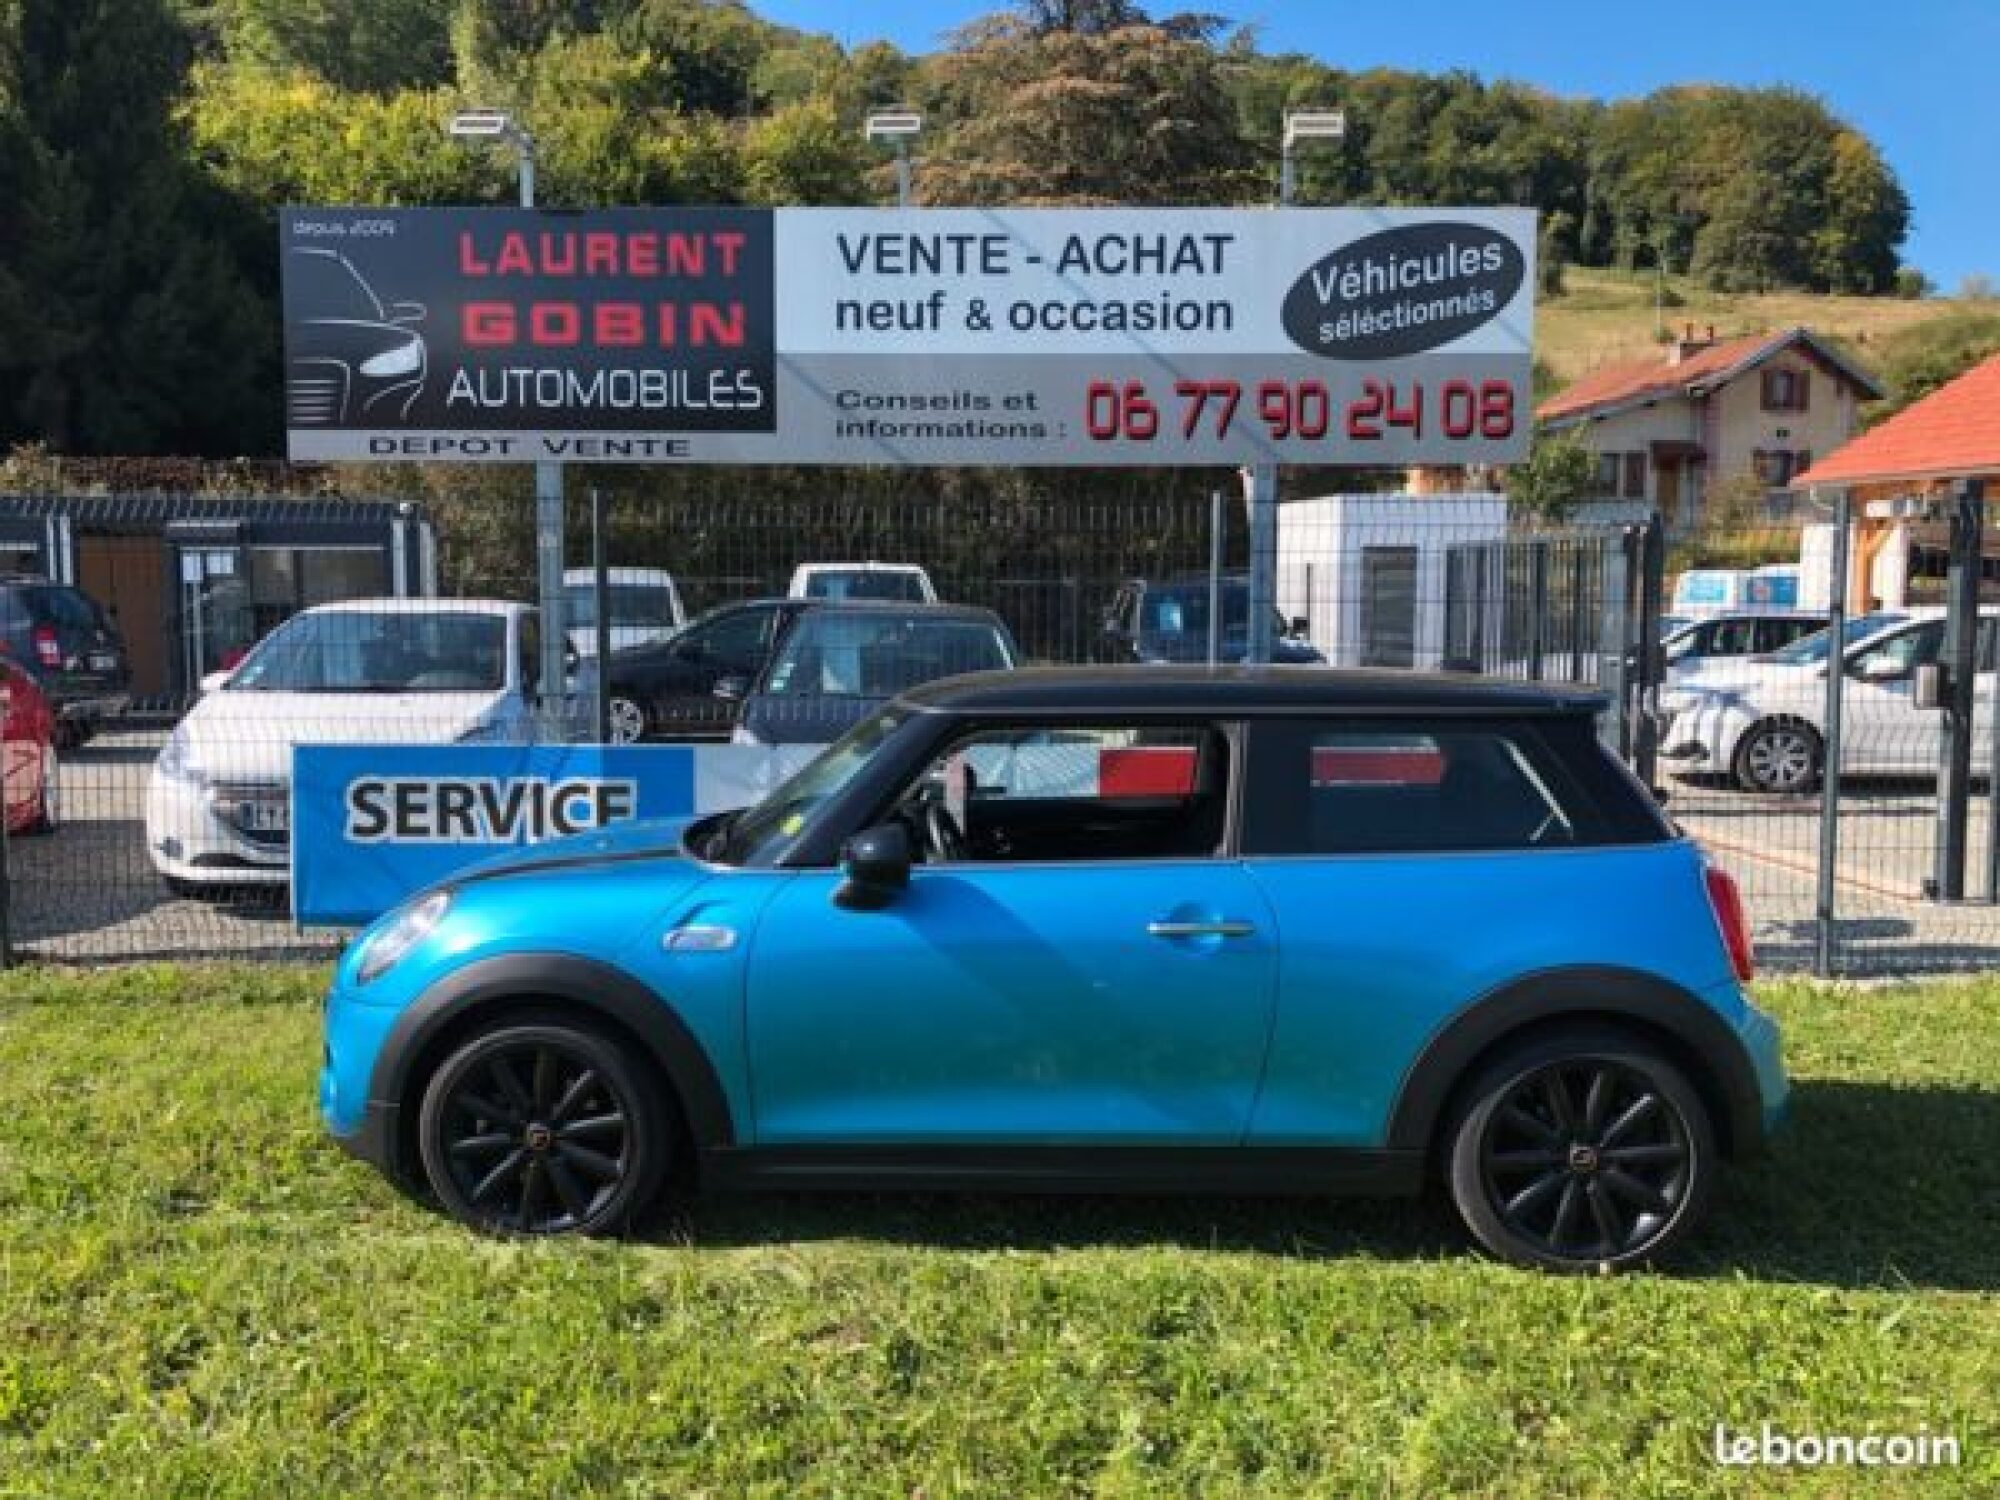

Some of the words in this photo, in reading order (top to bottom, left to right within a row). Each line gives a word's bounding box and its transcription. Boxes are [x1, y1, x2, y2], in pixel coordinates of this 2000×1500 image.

[459, 232, 746, 276] LAURENT
[836, 234, 1011, 275] VENTE
[1056, 234, 1236, 275] ACHAT
[1312, 243, 1504, 304] Véhicules
[464, 303, 746, 347] GOBIN
[836, 290, 946, 331] neuf
[965, 297, 993, 331] &
[1007, 290, 1235, 331] occasion
[446, 368, 763, 409] AUTOMOBILES
[836, 389, 991, 411] Conseils
[1002, 389, 1041, 411] et
[836, 419, 1048, 438] informations
[1087, 381, 1160, 441] 06
[1174, 381, 1241, 441] 77
[1257, 381, 1329, 441] 90
[1345, 381, 1424, 441] 24
[1440, 381, 1515, 441] 08
[369, 436, 518, 455] DEPOT
[543, 437, 692, 456] VENTE
[347, 779, 636, 841] SERVICE
